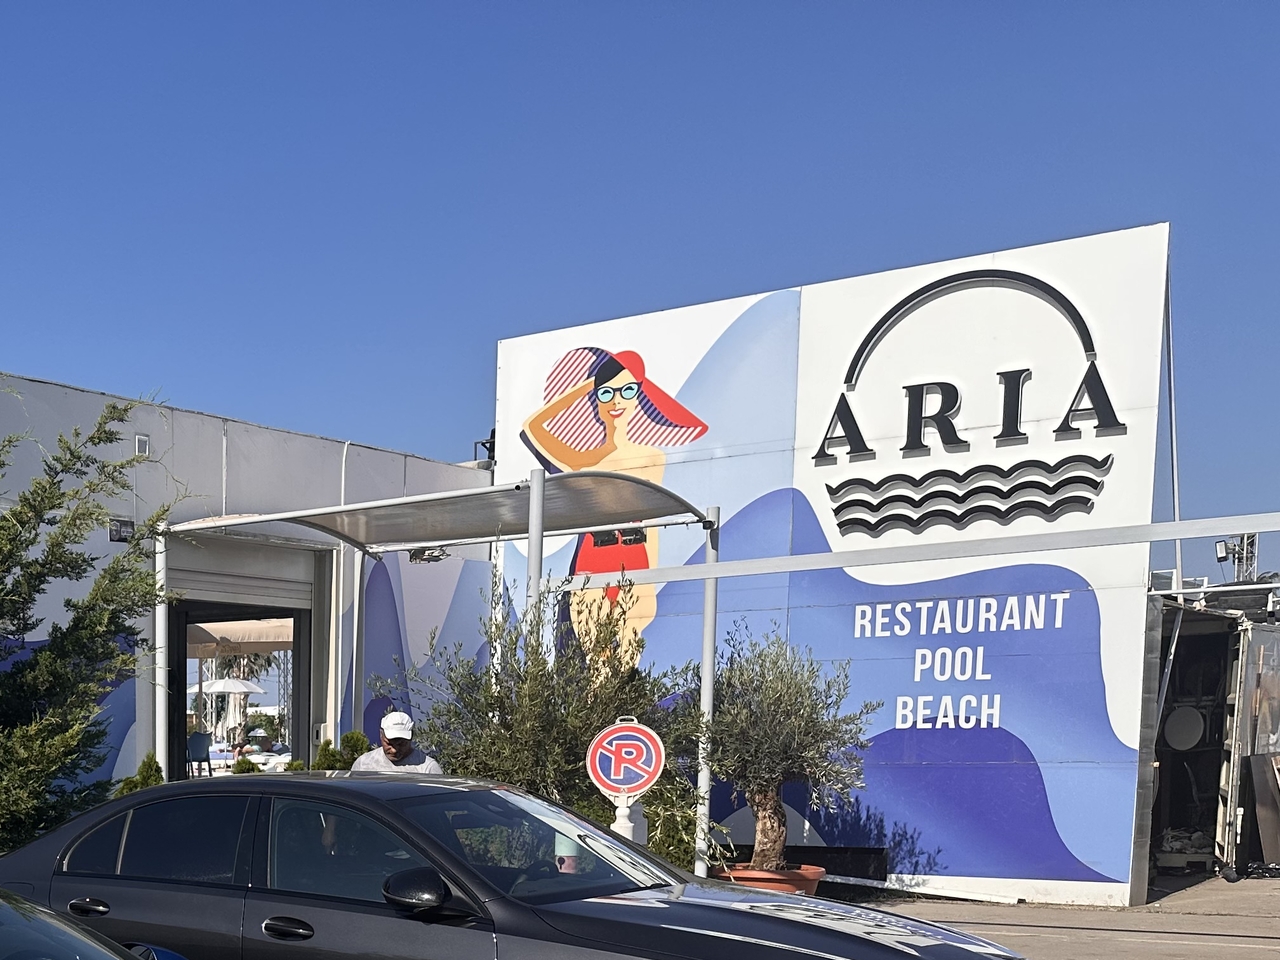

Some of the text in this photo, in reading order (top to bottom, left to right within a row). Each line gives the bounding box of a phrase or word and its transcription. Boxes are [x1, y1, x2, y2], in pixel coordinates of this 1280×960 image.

[811, 360, 1127, 464] ARIA
[854, 593, 1070, 638] RESTAURANT
[914, 646, 991, 682] POOL
[895, 694, 1001, 729] BEACH
